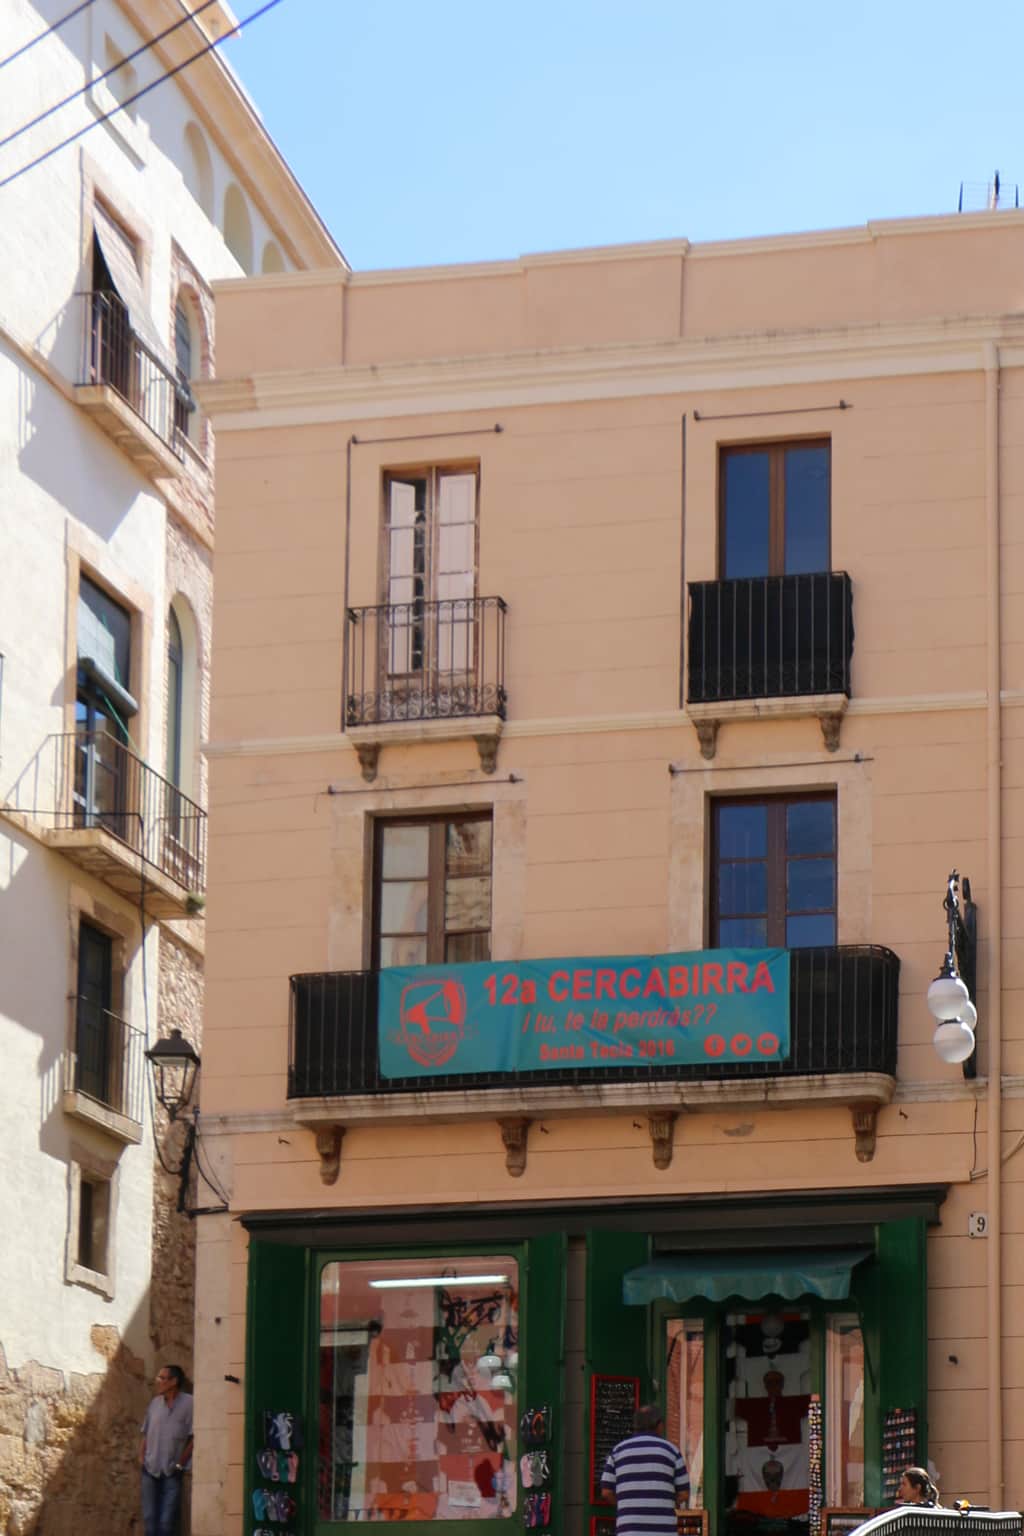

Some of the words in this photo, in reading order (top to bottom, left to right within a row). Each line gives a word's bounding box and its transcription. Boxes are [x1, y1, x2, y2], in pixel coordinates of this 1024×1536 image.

[483, 973, 537, 1005] 12a
[549, 961, 775, 1002] CERCABIRRA
[539, 1042, 585, 1061] Santa
[589, 1039, 634, 1060] Tecla
[976, 1216, 986, 1233] 9
